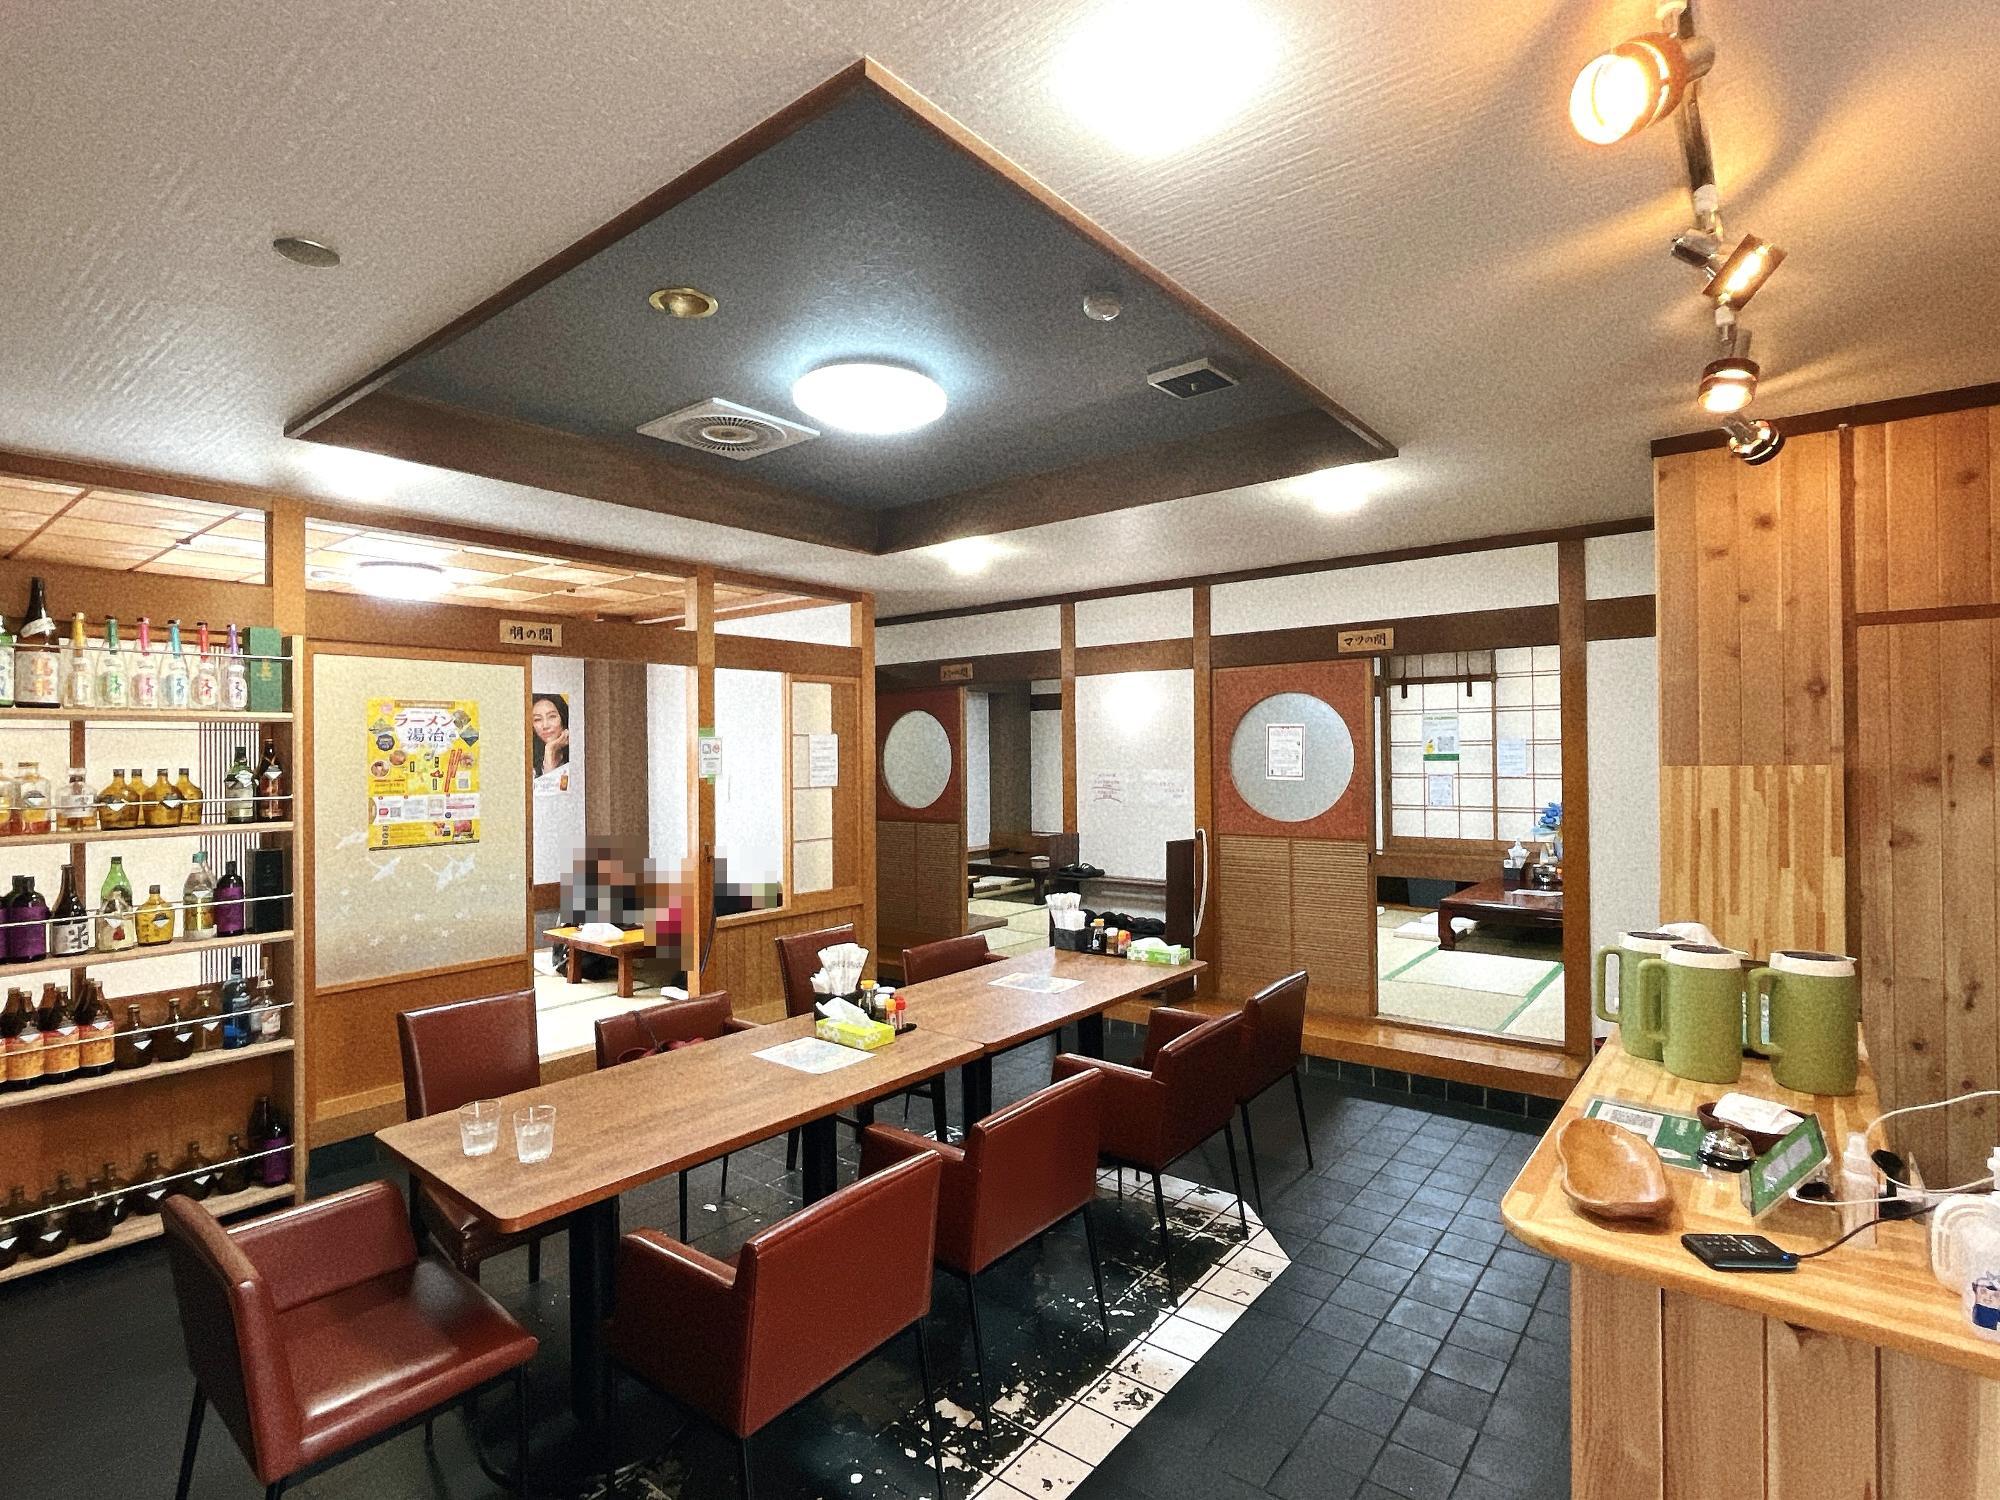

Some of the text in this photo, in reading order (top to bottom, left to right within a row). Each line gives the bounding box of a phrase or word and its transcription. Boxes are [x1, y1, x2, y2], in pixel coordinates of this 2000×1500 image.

[1344, 632, 1386, 647] マツの間
[394, 713, 454, 727] ラーメン
[408, 727, 445, 743] 湯治
